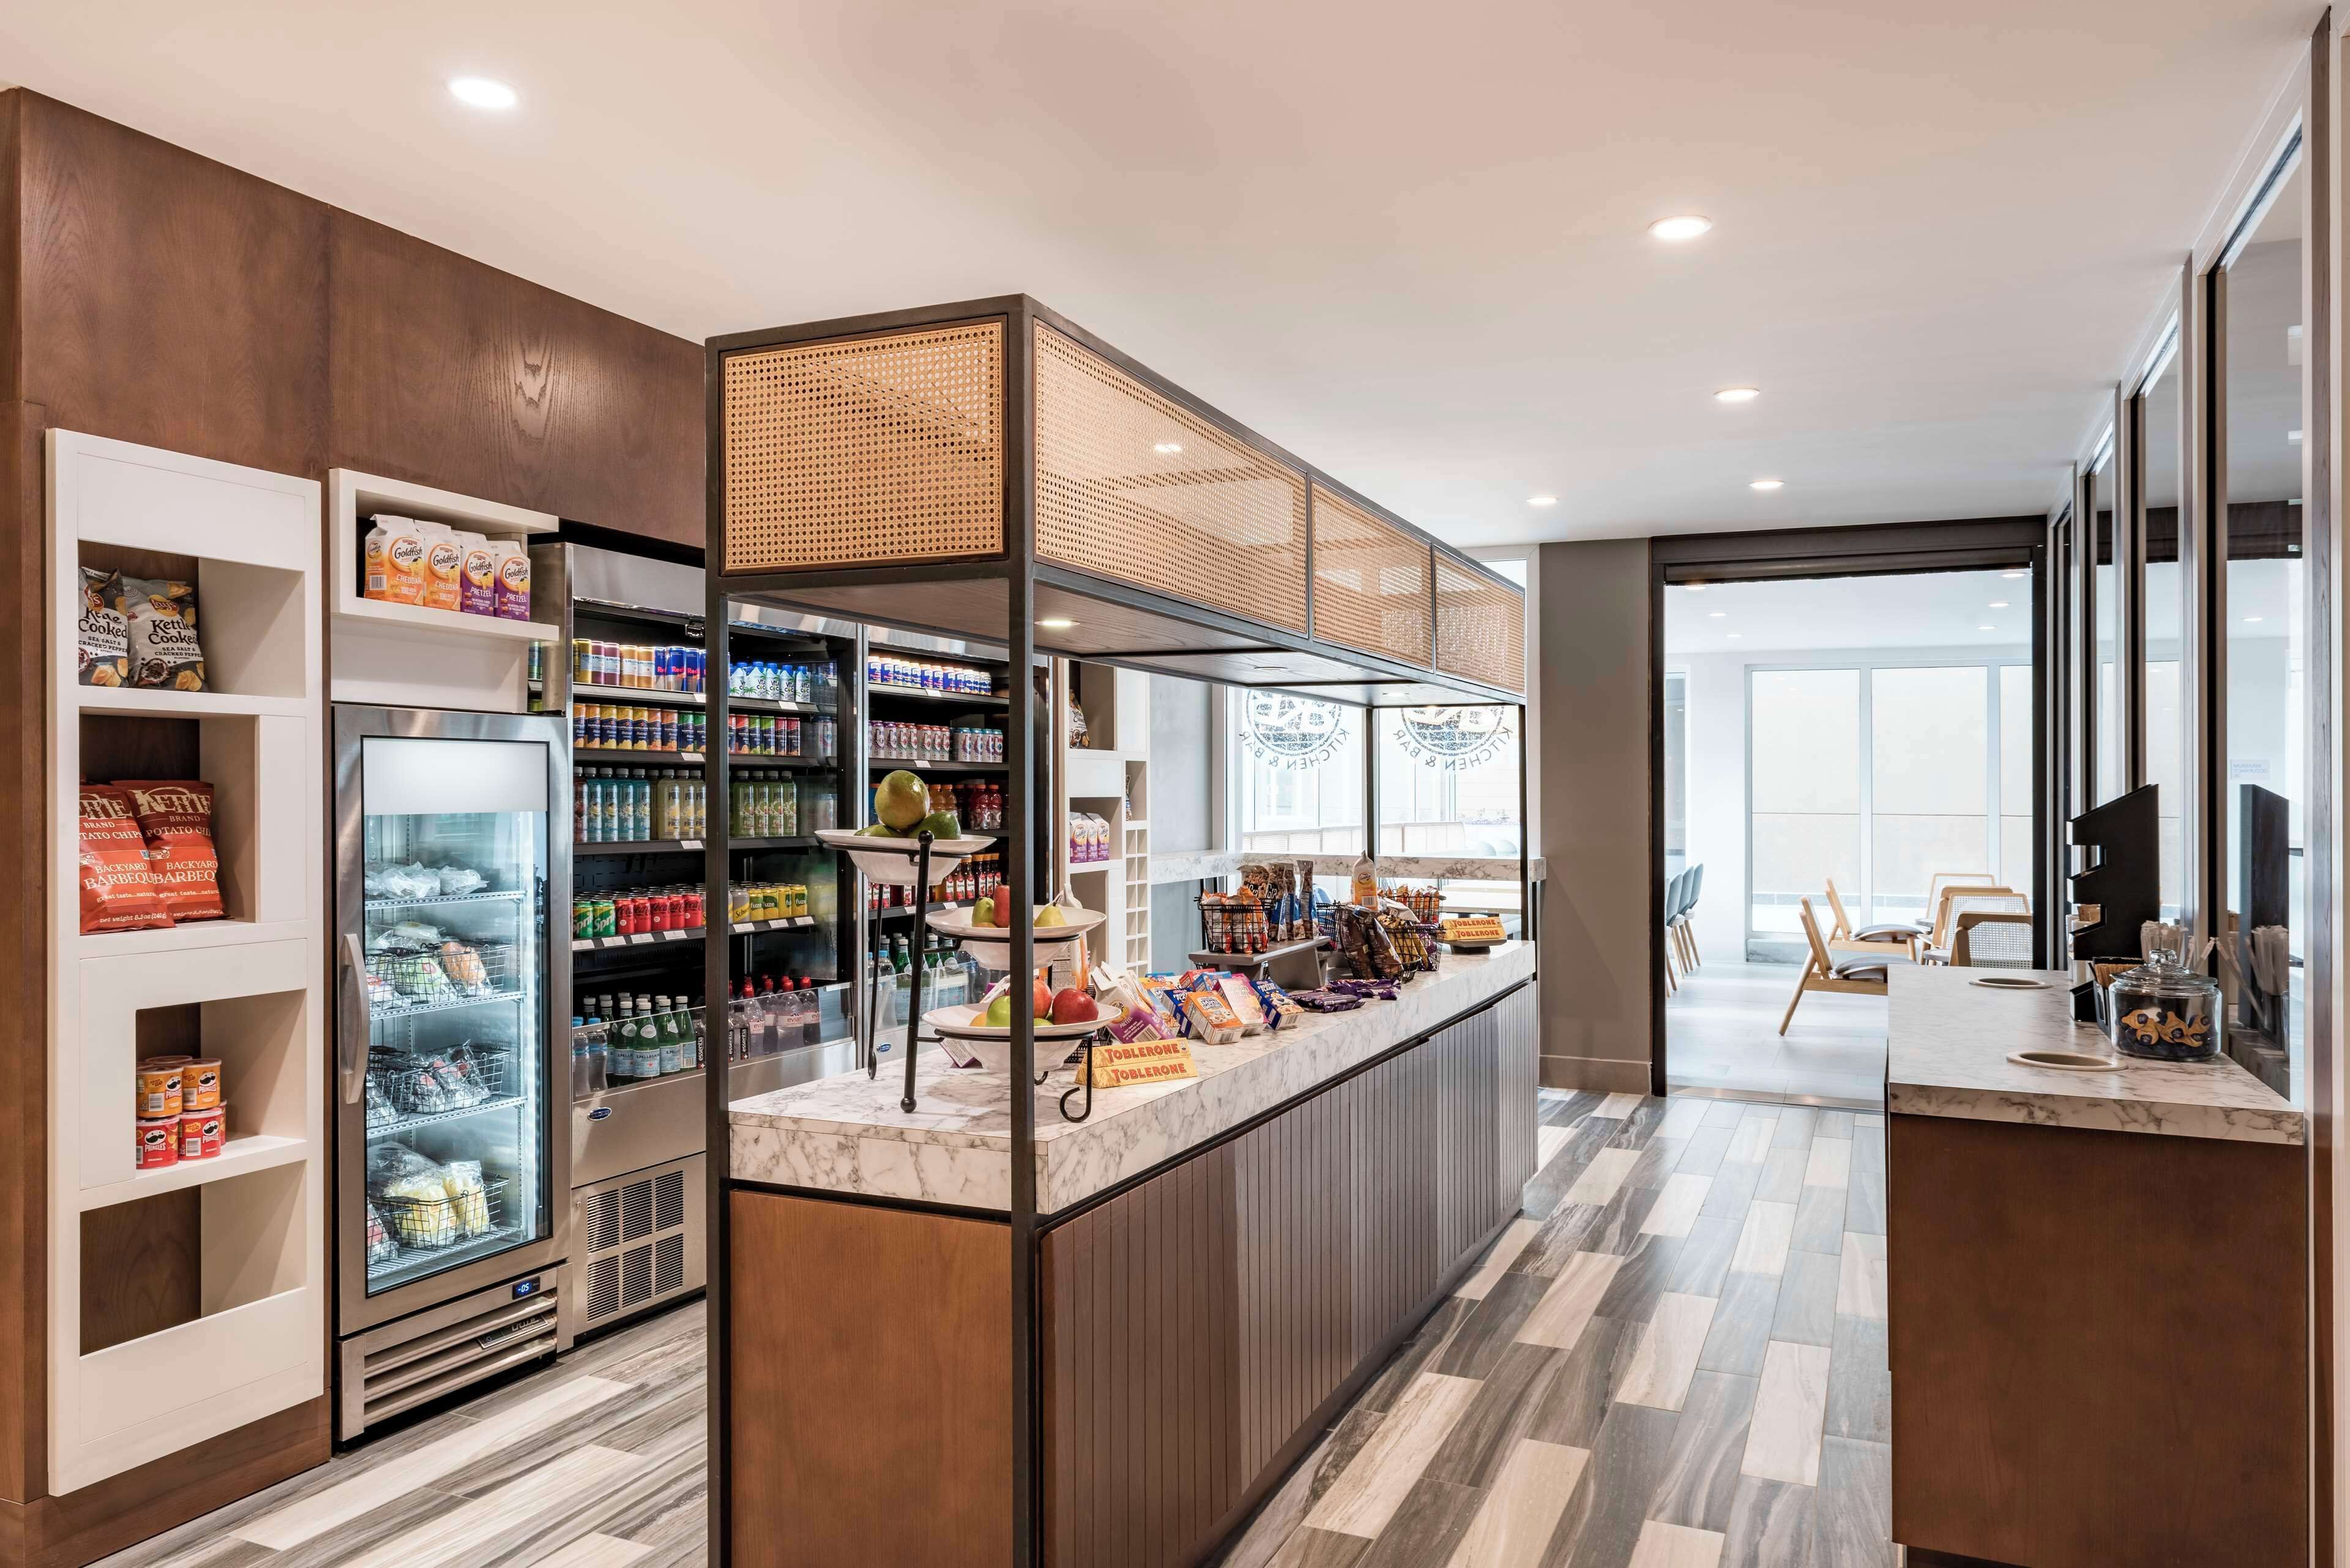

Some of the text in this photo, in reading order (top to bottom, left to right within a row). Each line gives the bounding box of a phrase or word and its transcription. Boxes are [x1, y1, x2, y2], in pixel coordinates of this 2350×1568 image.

[394, 545, 422, 559] Goldfish
[433, 553, 459, 566] Goldfish
[469, 561, 493, 573] Goldfish
[504, 567, 529, 579] Goldfish
[396, 573, 422, 584] CHEDDAR
[435, 581, 458, 591] CHEDDAR
[470, 586, 492, 597] PRETZEL
[506, 592, 528, 603] PRETZEL
[78, 618, 127, 638] Cooked
[79, 793, 133, 820] TTLE
[128, 786, 212, 818] KETTLE
[79, 831, 143, 840] TATO CHIPS
[145, 826, 211, 838] POTATO CHI
[95, 862, 148, 874] BACKYARD
[167, 861, 219, 870] BACKYARD
[83, 872, 154, 890] BARBEQU
[154, 870, 217, 884] BARBEQ
[112, 914, 134, 923] weight
[1452, 919, 1496, 928] TOBLERONE
[1105, 1043, 1180, 1063] TOBLERONE
[1111, 1063, 1187, 1083] TOBLERONE
[198, 1084, 217, 1095] PRINGLES
[203, 1134, 219, 1143] PRINGLES
[145, 1142, 167, 1153] PRINGLES
